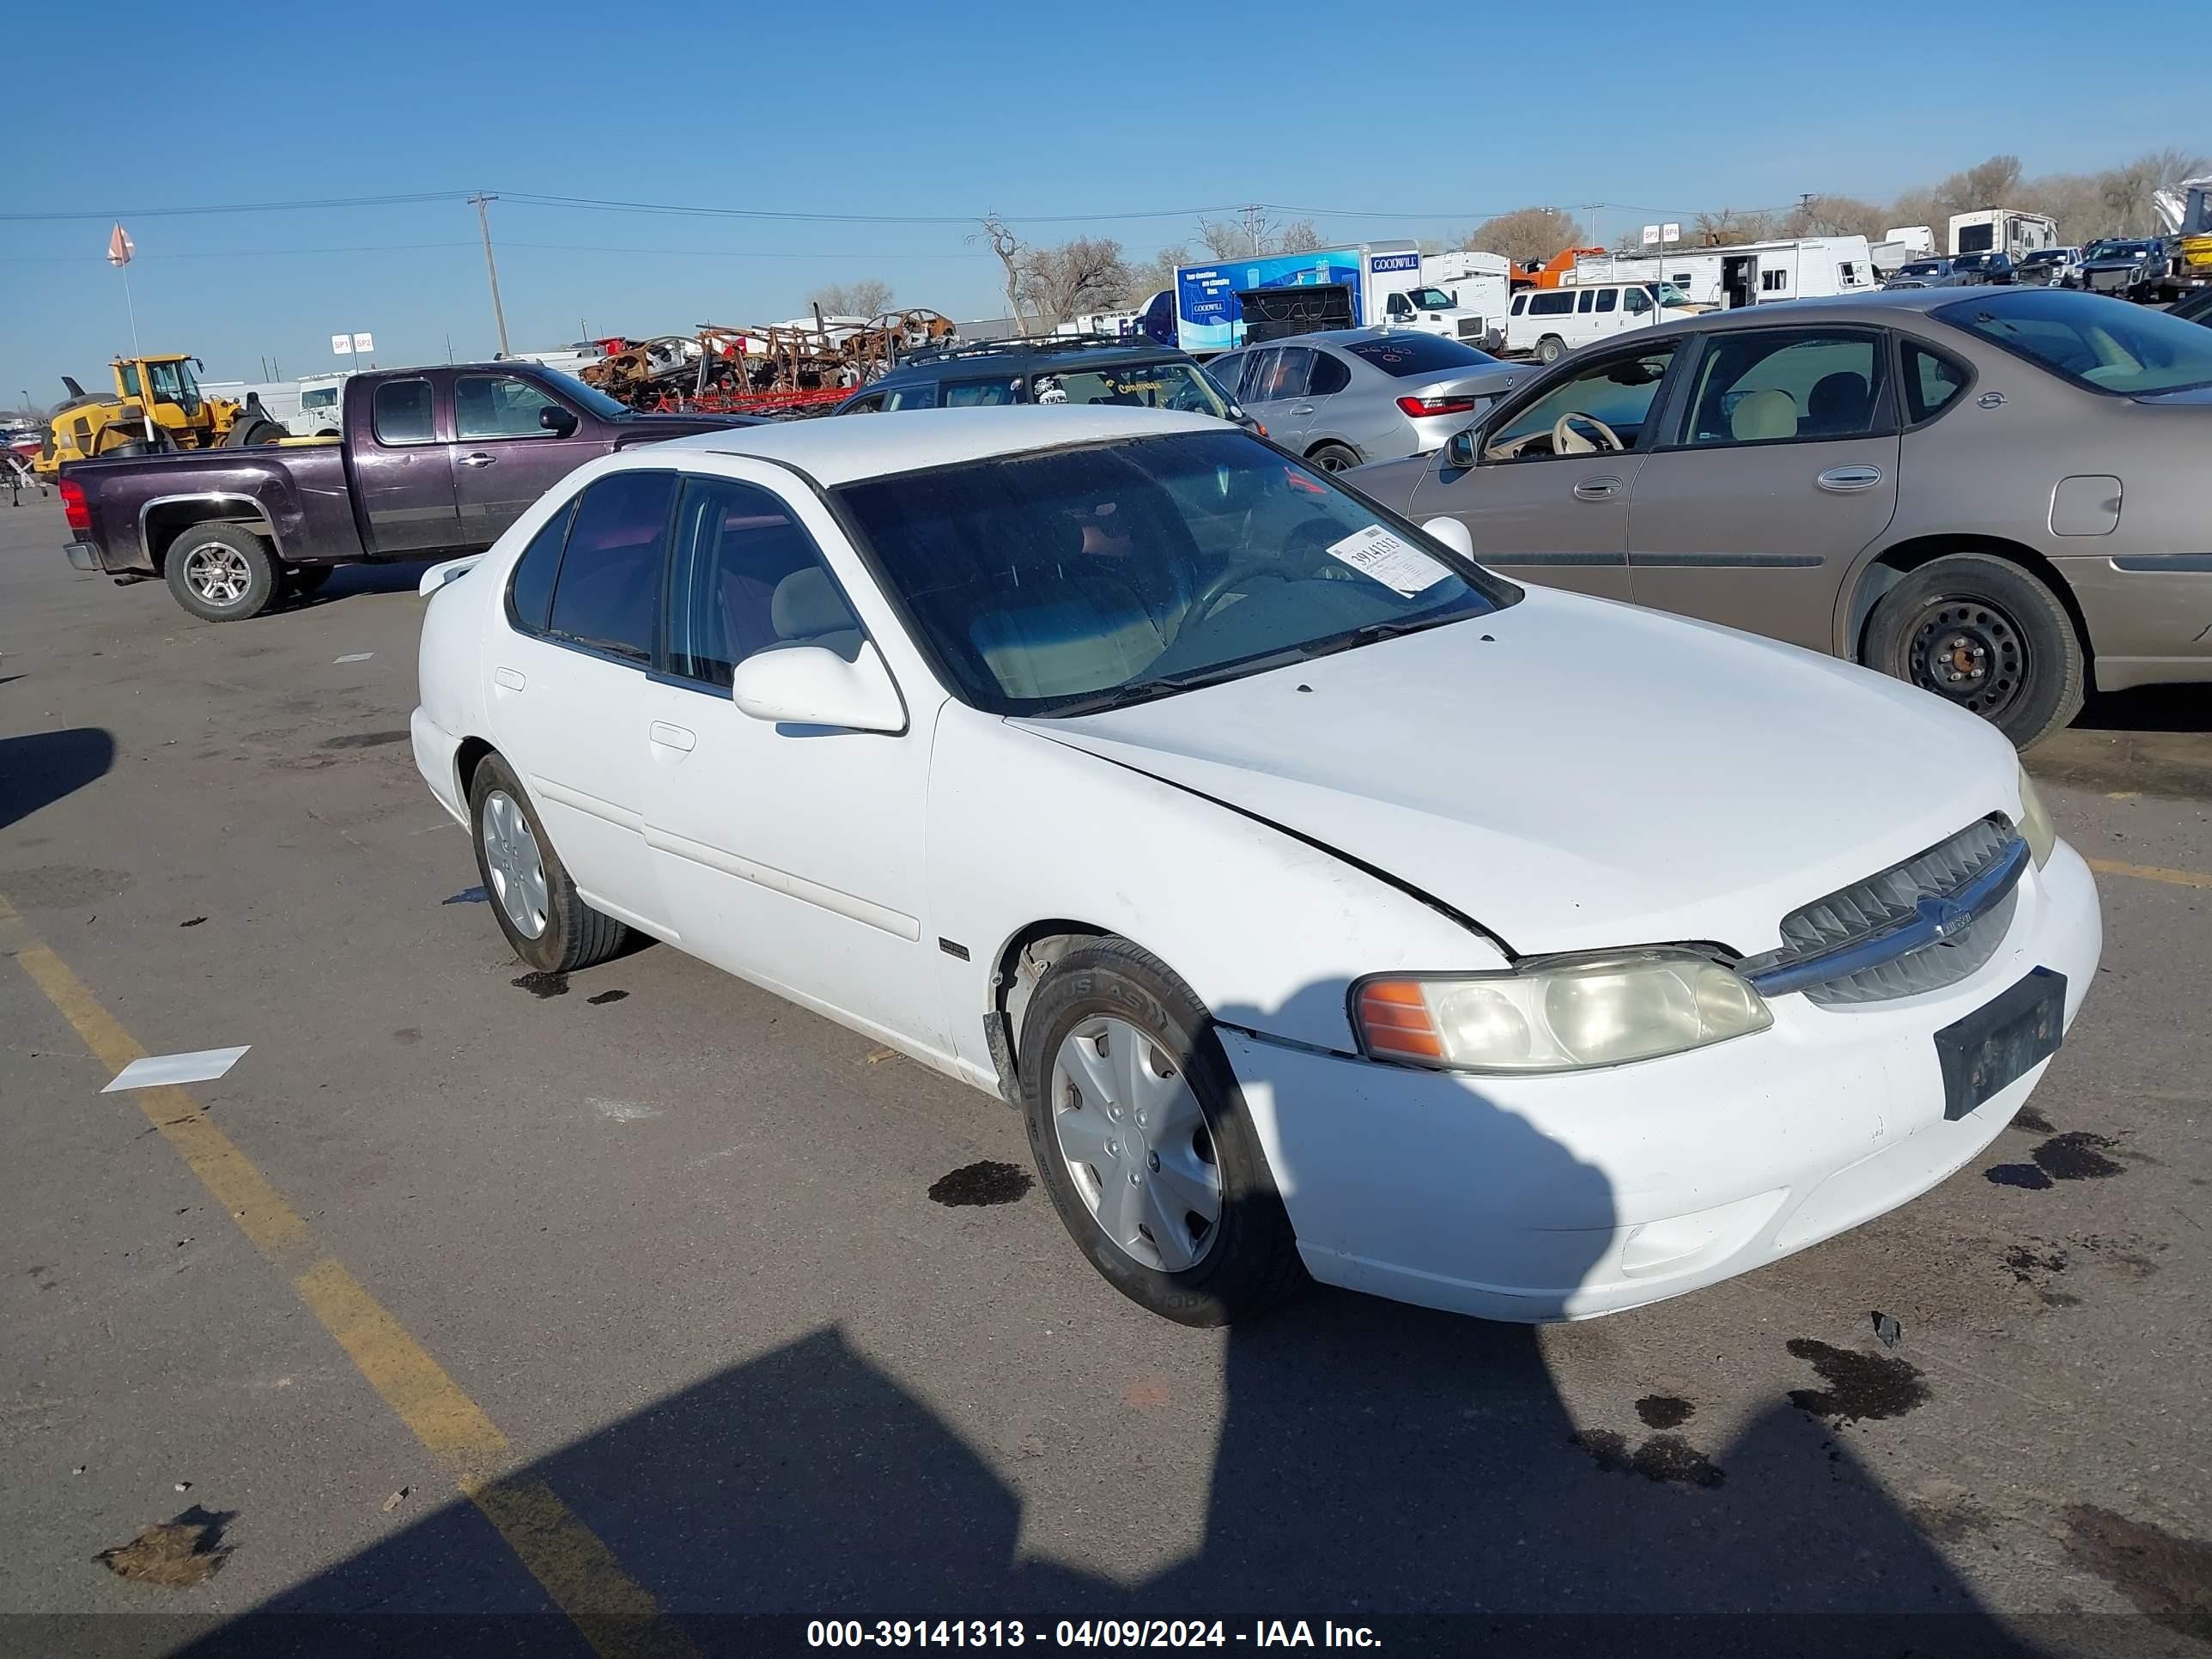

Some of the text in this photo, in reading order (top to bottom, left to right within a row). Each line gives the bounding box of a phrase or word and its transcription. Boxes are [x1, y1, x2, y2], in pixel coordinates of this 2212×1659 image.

[1374, 257, 1417, 270] GOODWILL
[1194, 303, 1224, 313] GOODWILL
[1352, 538, 1401, 566] 39141313
